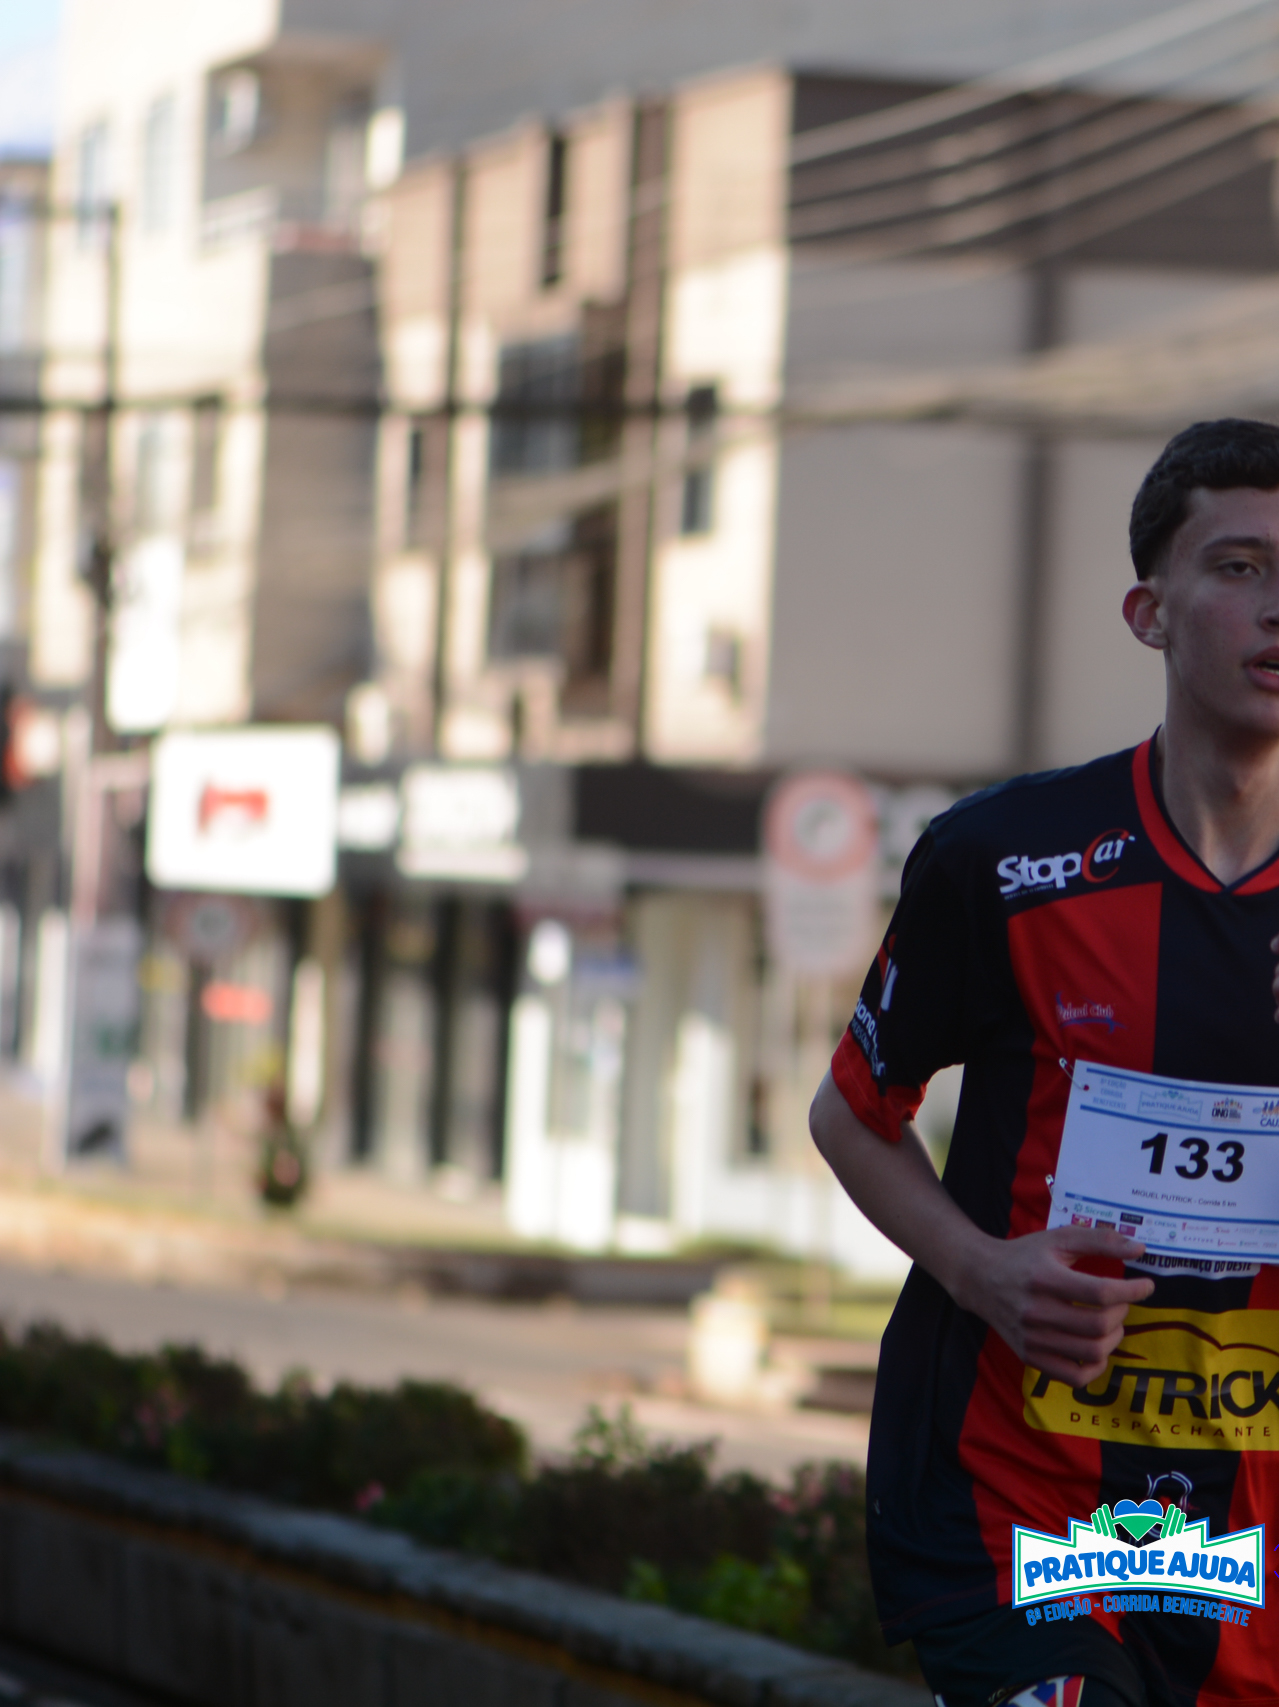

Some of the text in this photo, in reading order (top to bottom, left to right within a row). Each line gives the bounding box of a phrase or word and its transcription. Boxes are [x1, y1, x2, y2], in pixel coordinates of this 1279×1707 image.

[1141, 1100, 1176, 1111] PRATIQUE
[1140, 1132, 1246, 1184] 133
[1131, 1188, 1159, 1200] MIGUEL
[1161, 1193, 1193, 1204] PUTRICK
[1198, 1198, 1221, 1207] Corrida
[1227, 1200, 1237, 1208] km
[1084, 1205, 1114, 1218] Sicredi
[1158, 1255, 1212, 1273] LOURENÇO
[1070, 1411, 1271, 1438] DESPACHANTE
